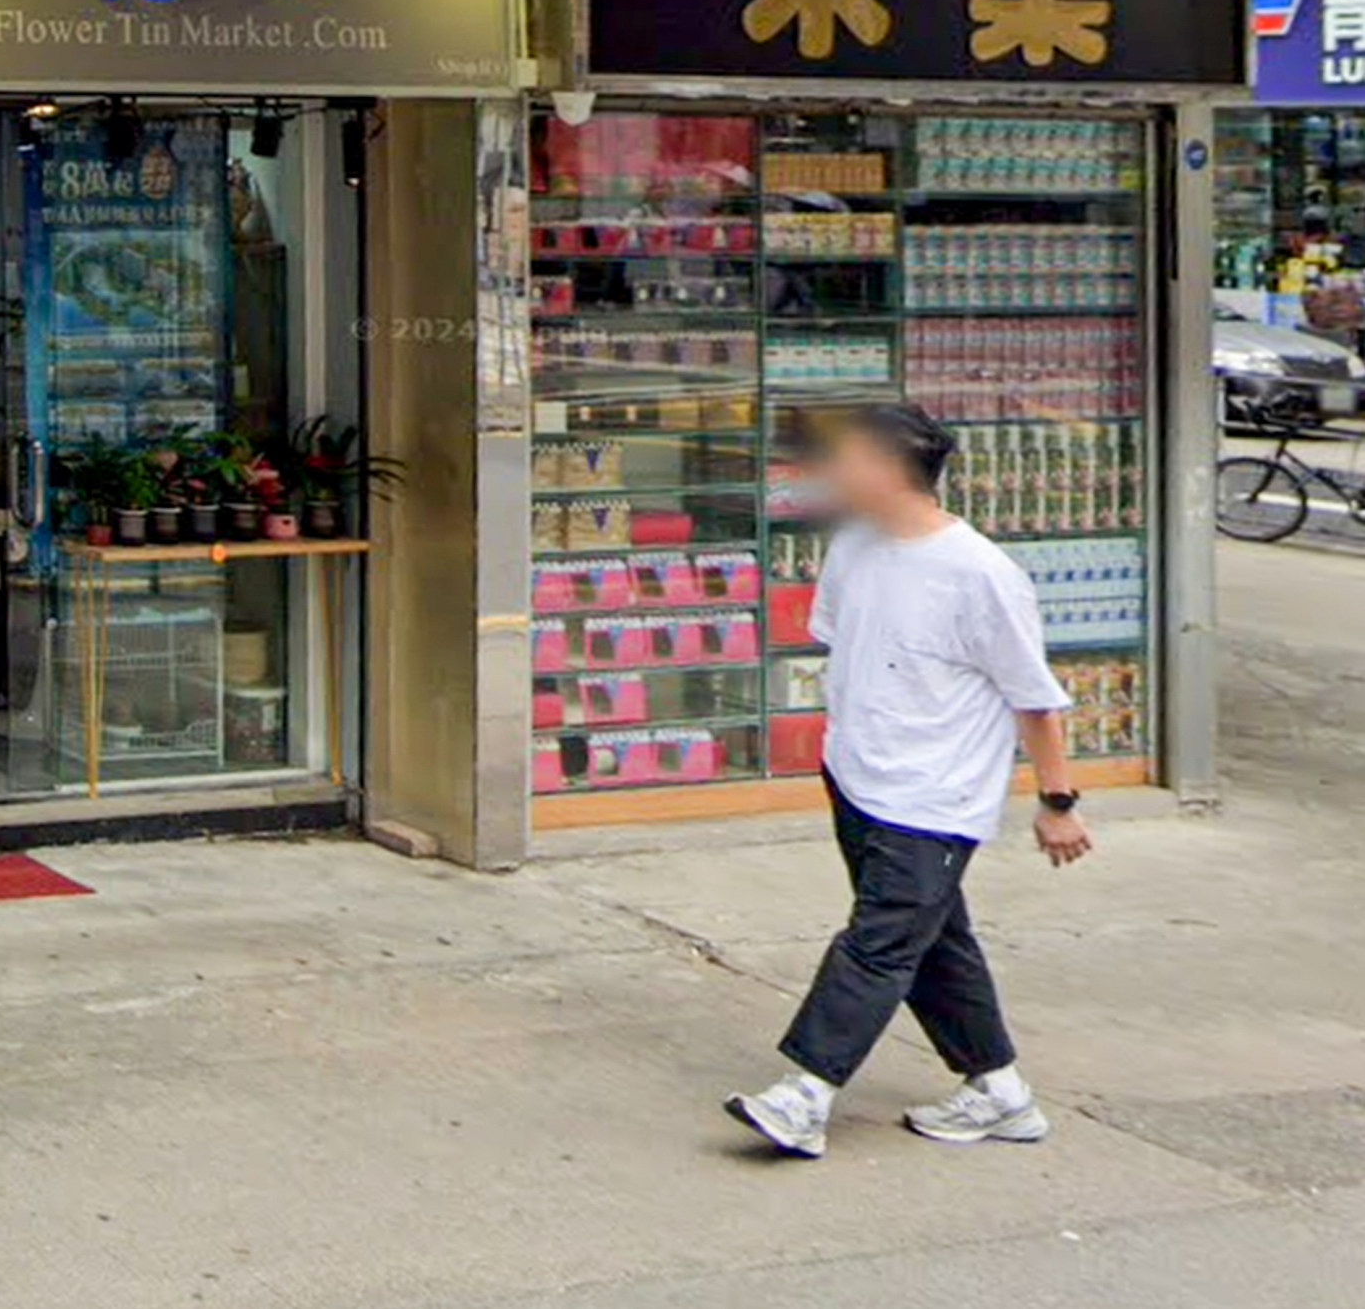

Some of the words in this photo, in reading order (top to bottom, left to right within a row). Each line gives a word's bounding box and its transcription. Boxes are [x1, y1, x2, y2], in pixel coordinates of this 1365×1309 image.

[115, 12, 170, 46] Tin
[178, 14, 295, 49] Market
[303, 17, 388, 51] .Com
